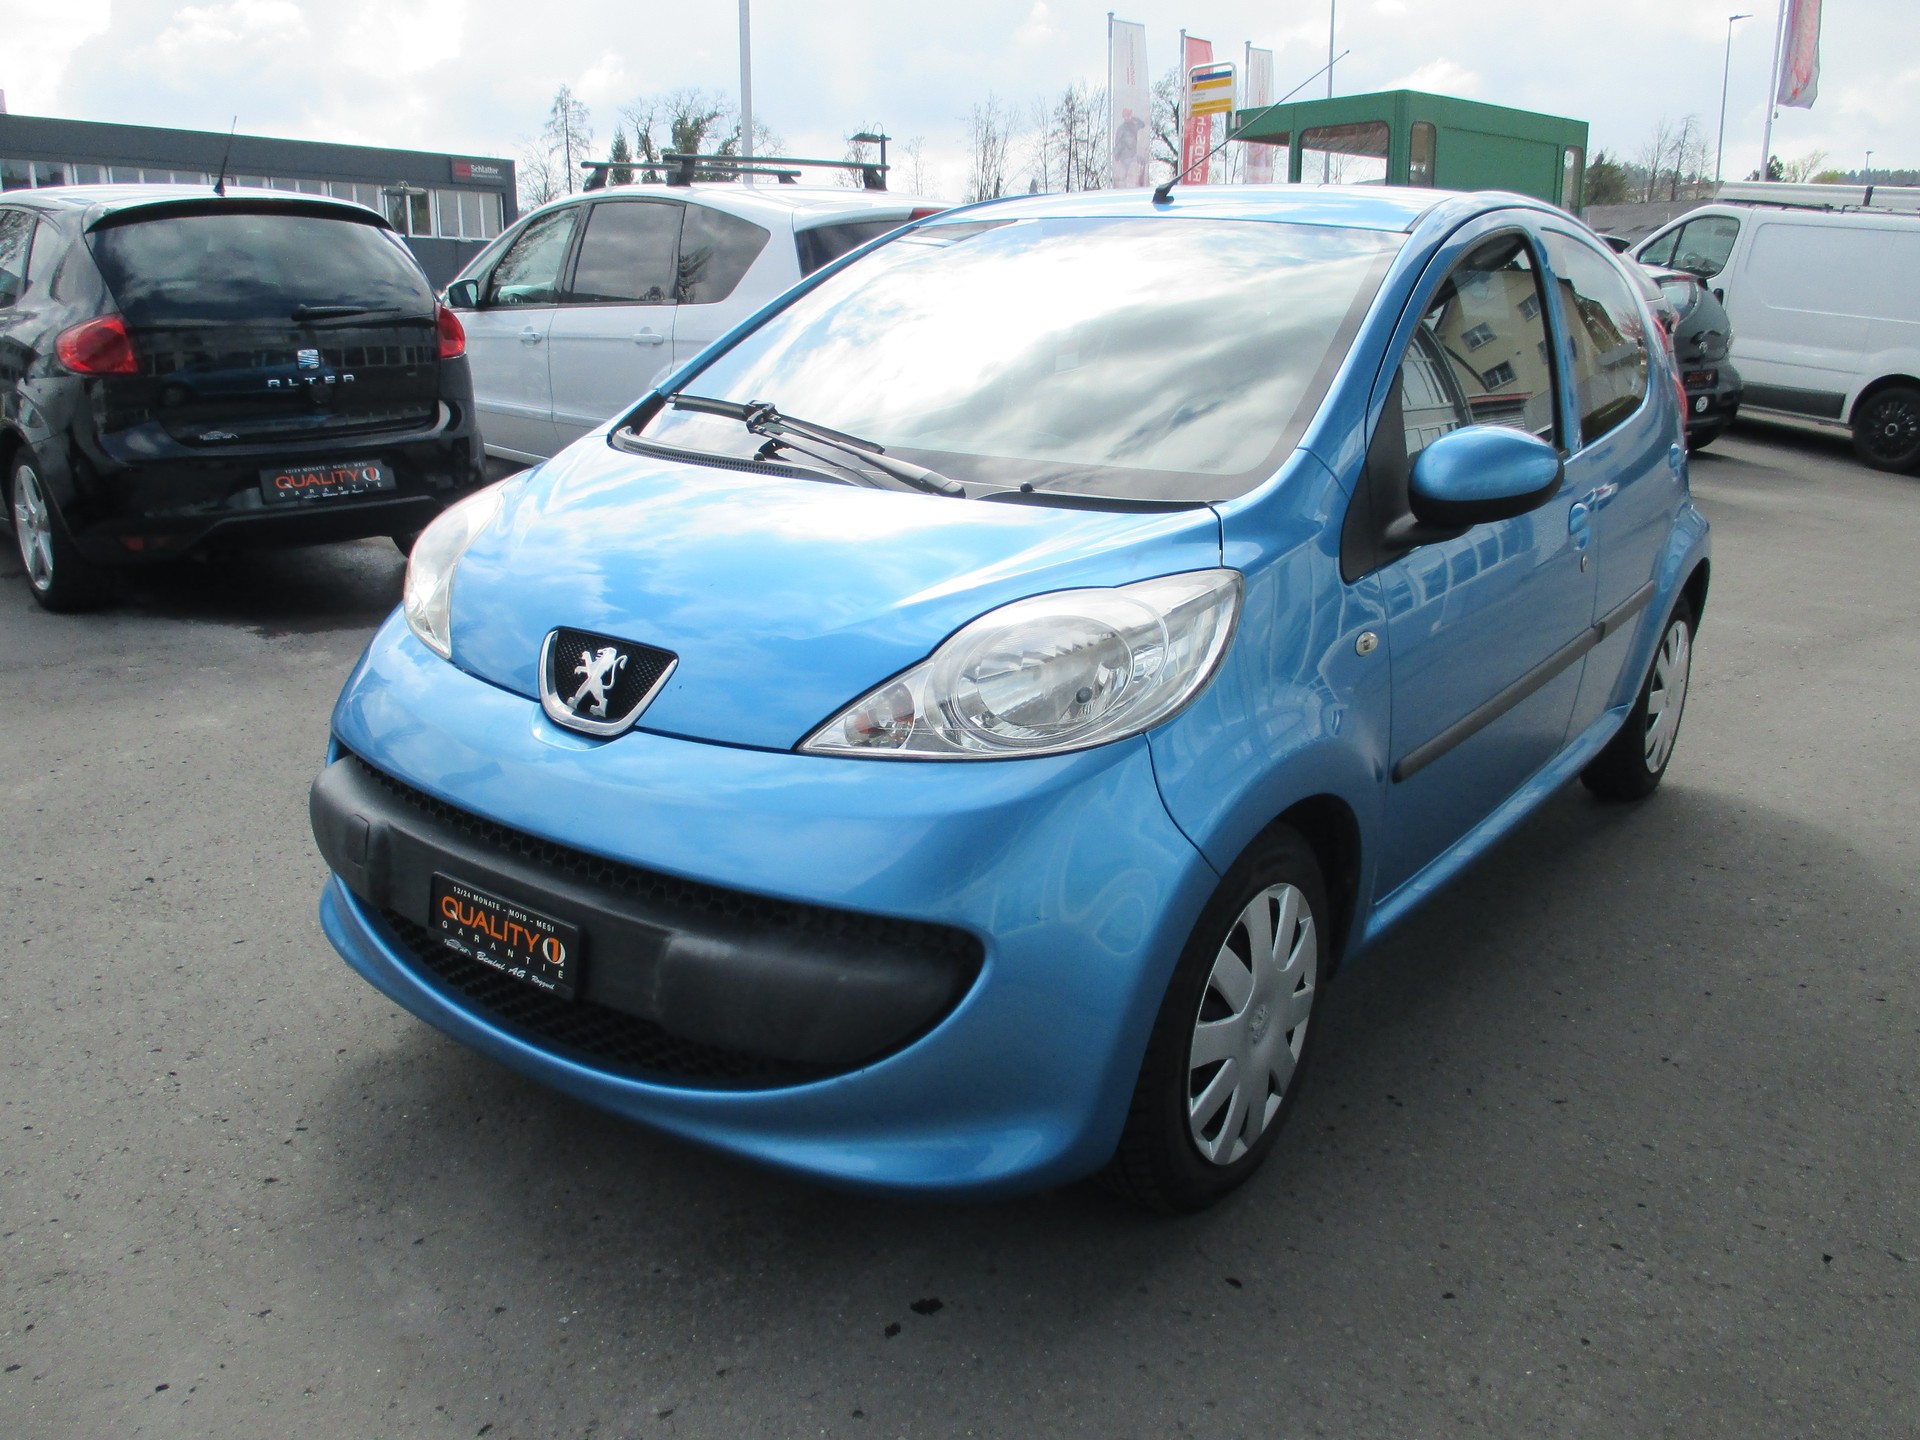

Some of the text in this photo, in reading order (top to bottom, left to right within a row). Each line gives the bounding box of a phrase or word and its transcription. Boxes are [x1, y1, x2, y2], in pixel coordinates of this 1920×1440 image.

[276, 469, 358, 488] QUALITY
[279, 482, 383, 498] GARANTIE
[441, 895, 541, 953] QUALITY
[453, 886, 555, 933] 12/24 MONATE MOIS MESI
[442, 920, 564, 979] GARANTIE
[508, 966, 527, 979] AG
